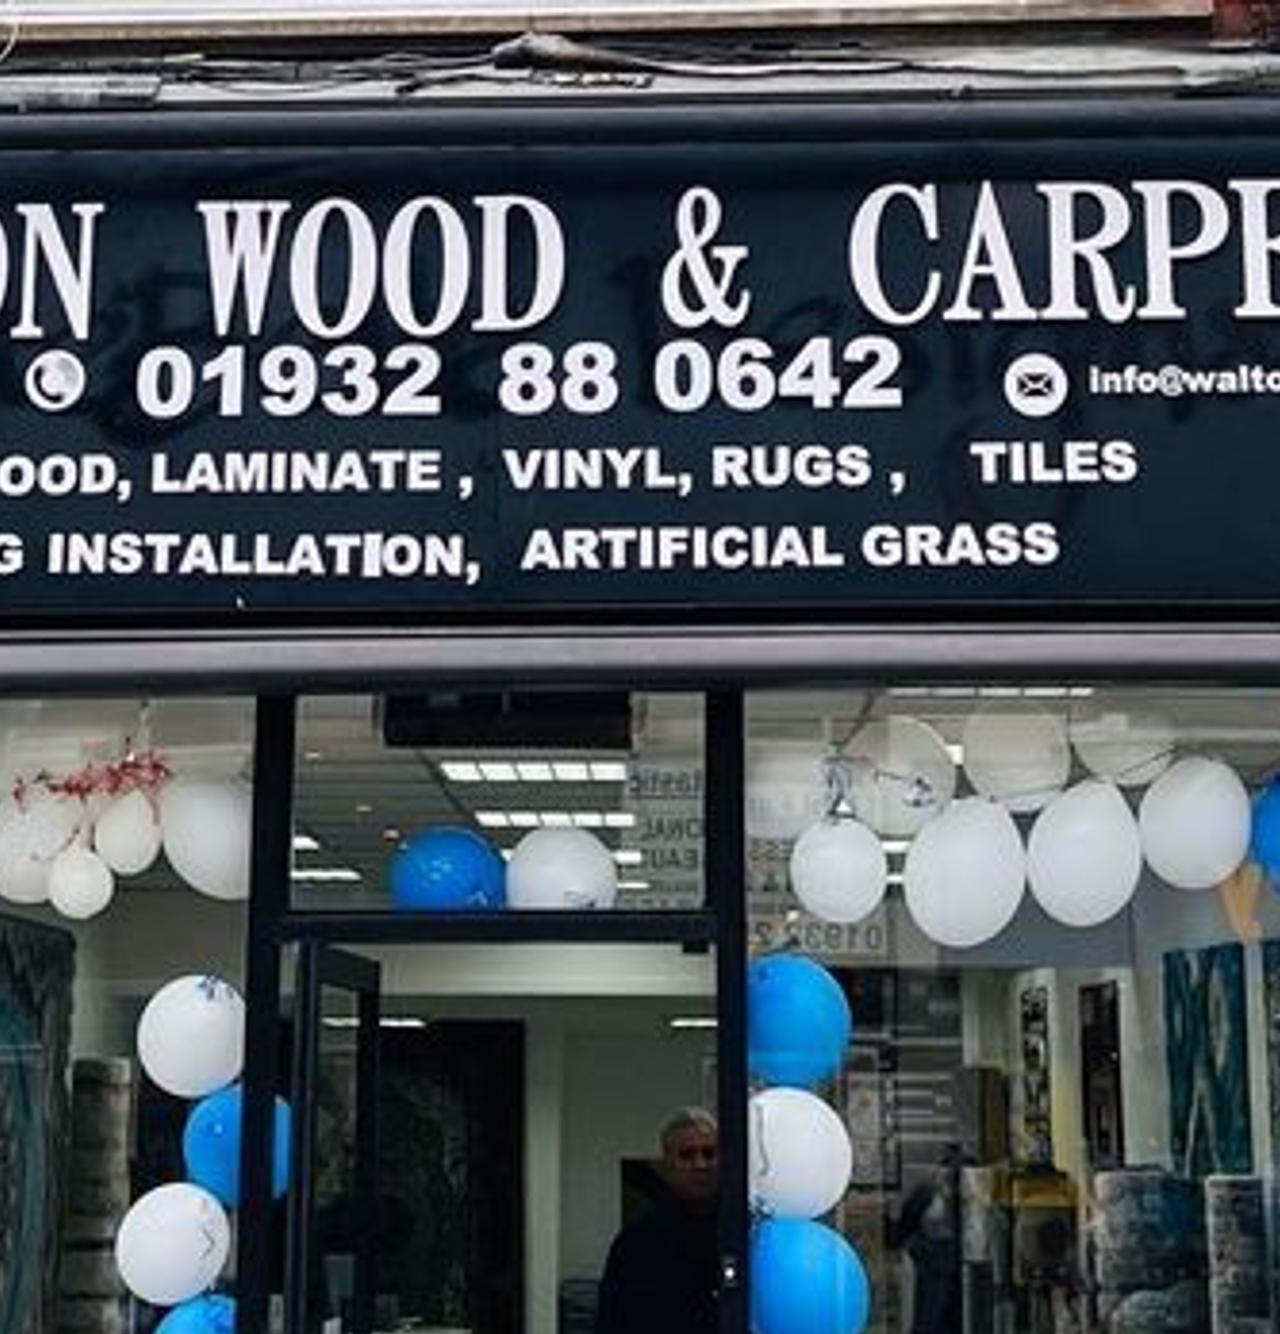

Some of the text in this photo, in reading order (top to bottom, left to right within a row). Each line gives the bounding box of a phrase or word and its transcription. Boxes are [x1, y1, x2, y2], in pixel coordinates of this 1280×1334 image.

[197, 194, 566, 340] WOOD
[661, 186, 753, 328] &
[136, 335, 903, 419] 01932 88 0642
[502, 447, 692, 497] VINYL,
[969, 440, 1138, 483] TILES
[48, 532, 480, 586] INSTALLATION,
[520, 525, 845, 570] ARTIFICIAL
[861, 522, 1060, 566] GRASS
